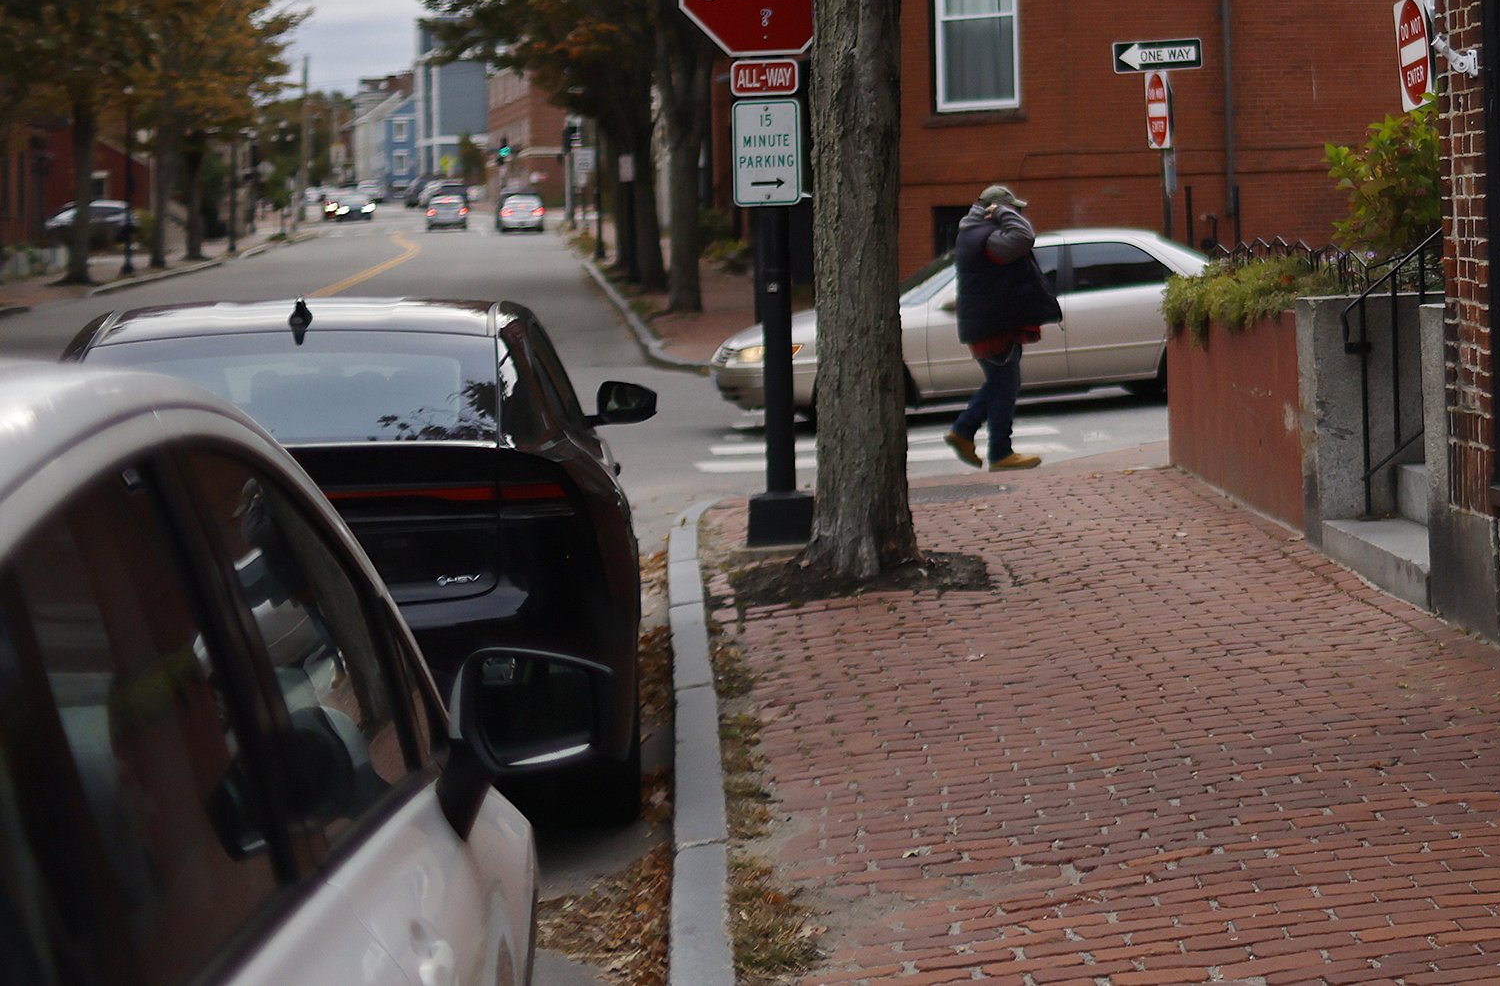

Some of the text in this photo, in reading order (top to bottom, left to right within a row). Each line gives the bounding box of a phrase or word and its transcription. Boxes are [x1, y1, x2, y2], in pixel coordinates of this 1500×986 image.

[1400, 15, 1421, 41] DO NOT
[1140, 48, 1191, 62] ONE WAY
[736, 67, 793, 88] ALL-WAY
[1406, 65, 1425, 87] ENTER
[760, 114, 773, 127] 15
[743, 134, 790, 148] MINUTE
[739, 155, 795, 169] PARKING
